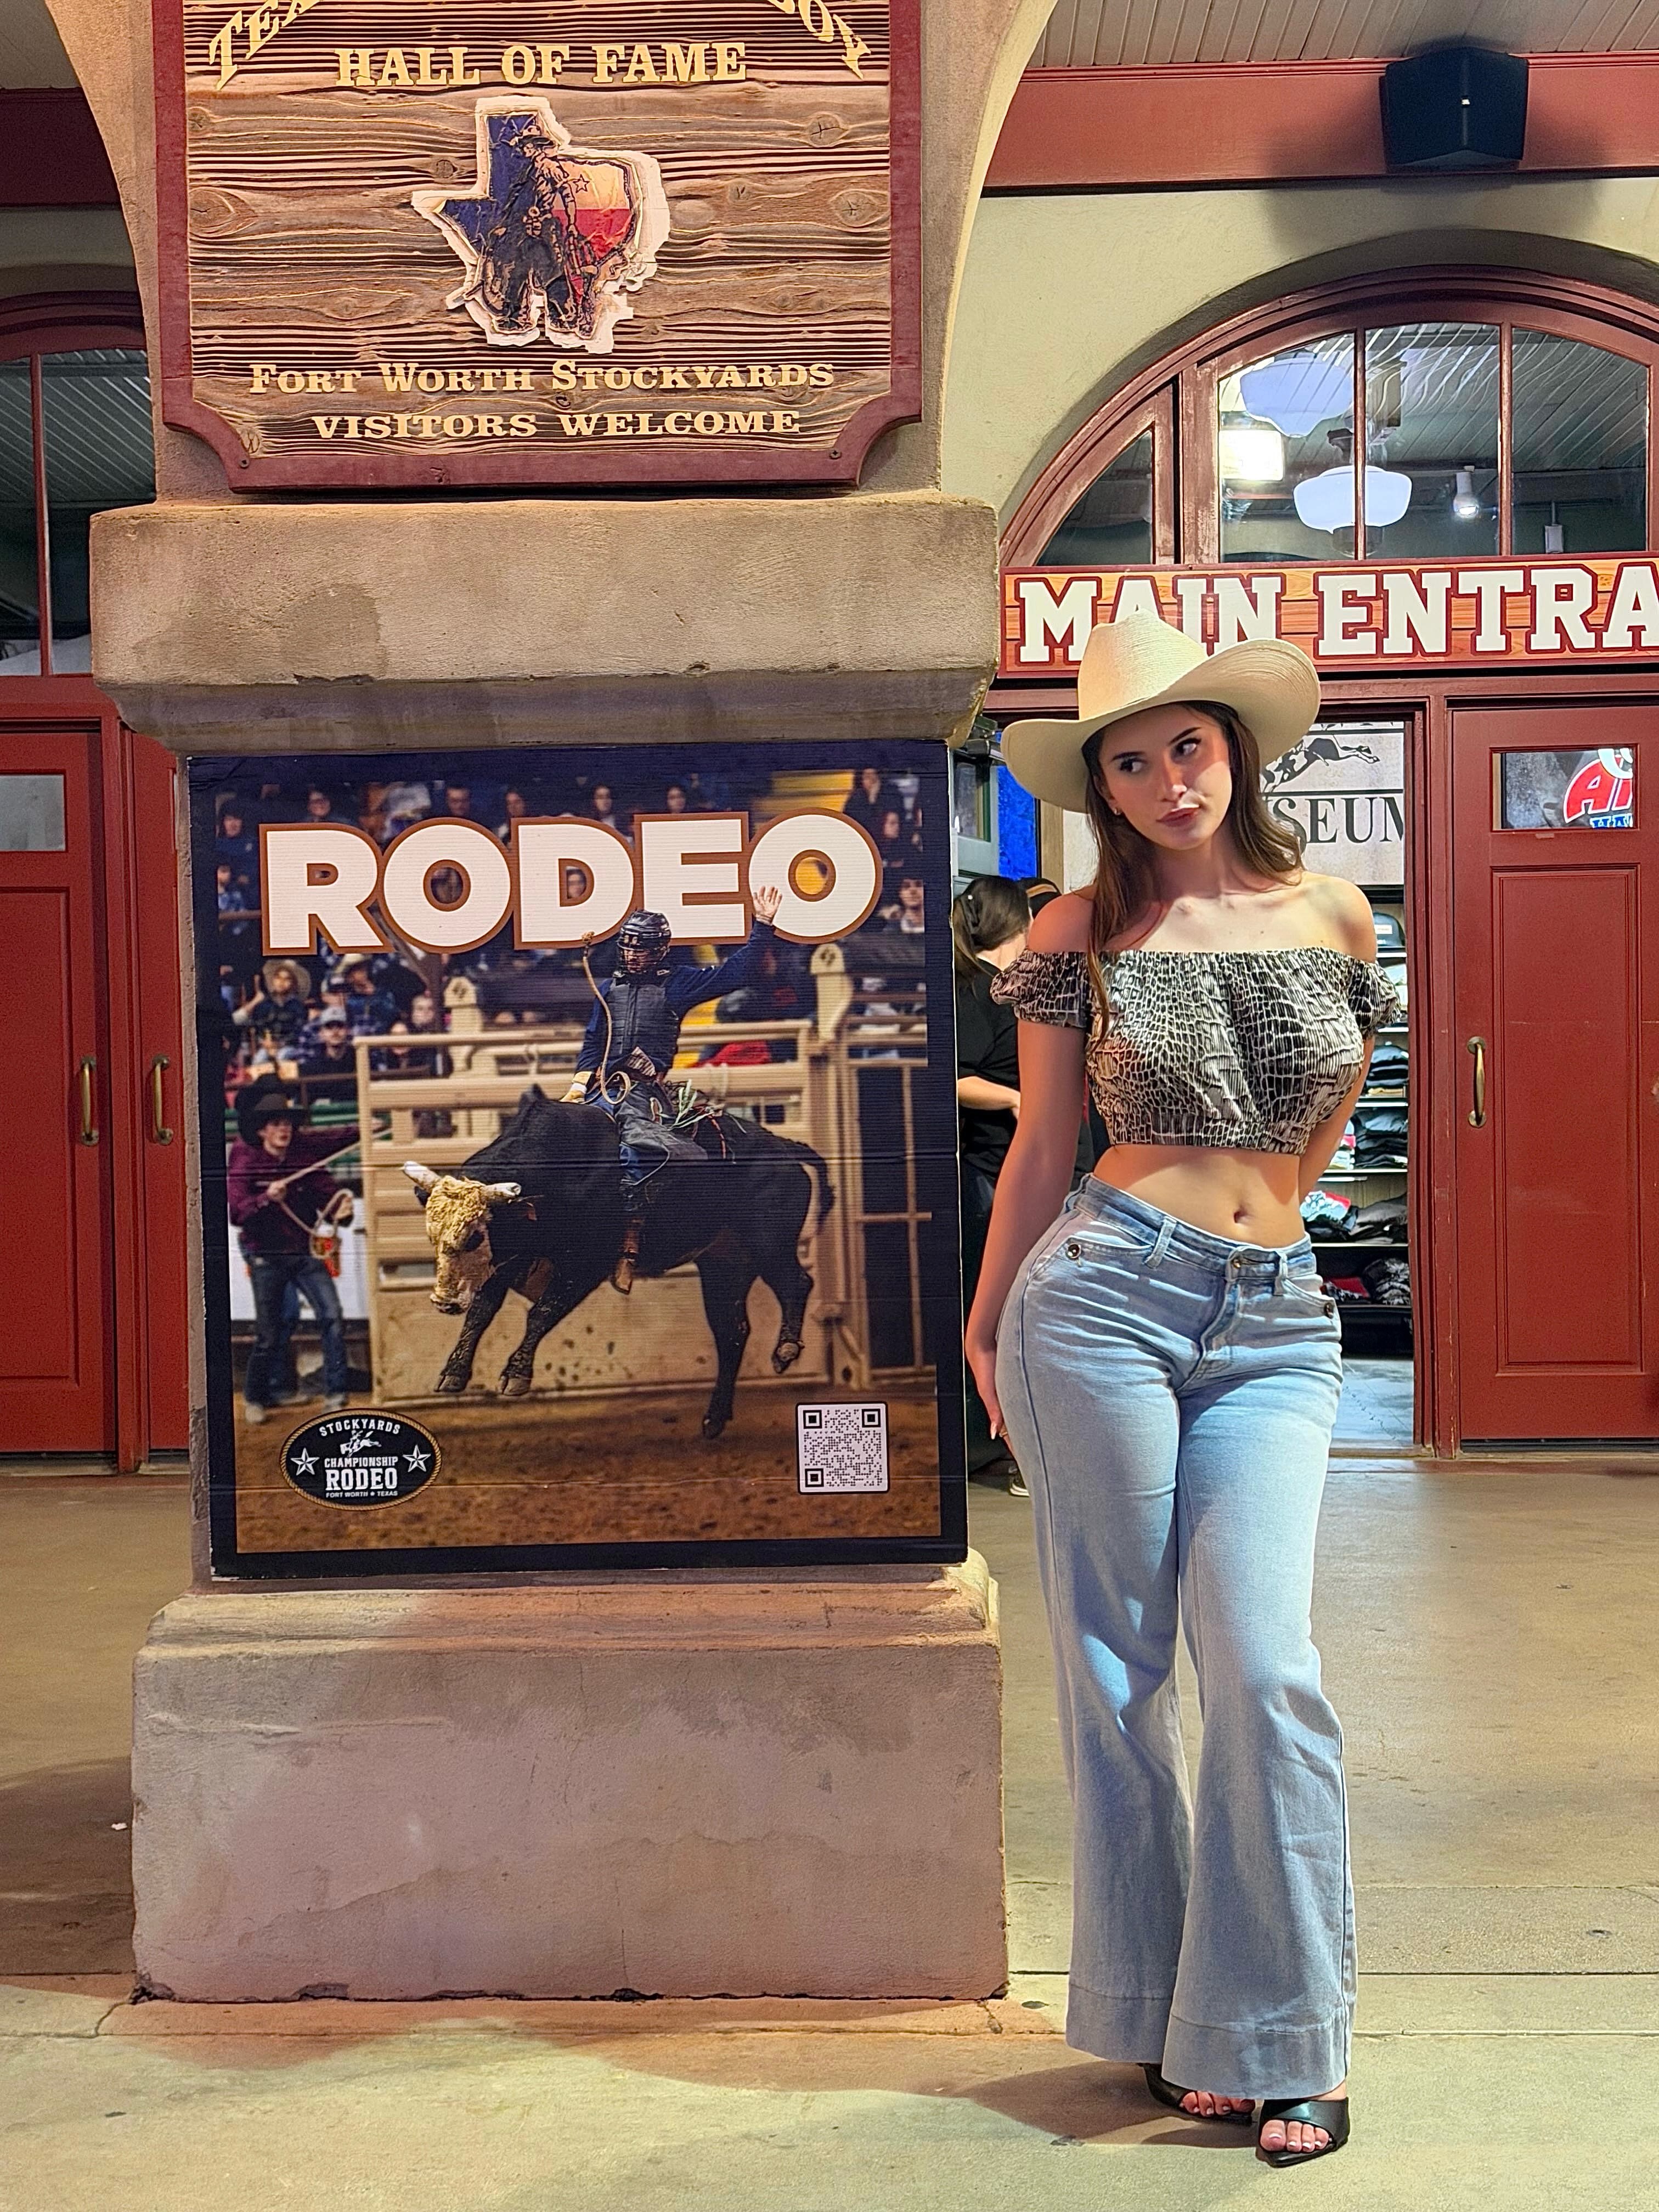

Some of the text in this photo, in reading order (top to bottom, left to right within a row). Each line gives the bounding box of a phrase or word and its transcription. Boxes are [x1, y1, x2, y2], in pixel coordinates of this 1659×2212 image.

[335, 42, 746, 86] HALL OF FAME
[312, 410, 799, 438] VISITORS WELCOME
[259, 808, 883, 956] RODEO
[319, 1418, 400, 1437] STOCKYARDS
[324, 1456, 398, 1468] CHAMPIONSHIP
[325, 1468, 398, 1491] RODEO
